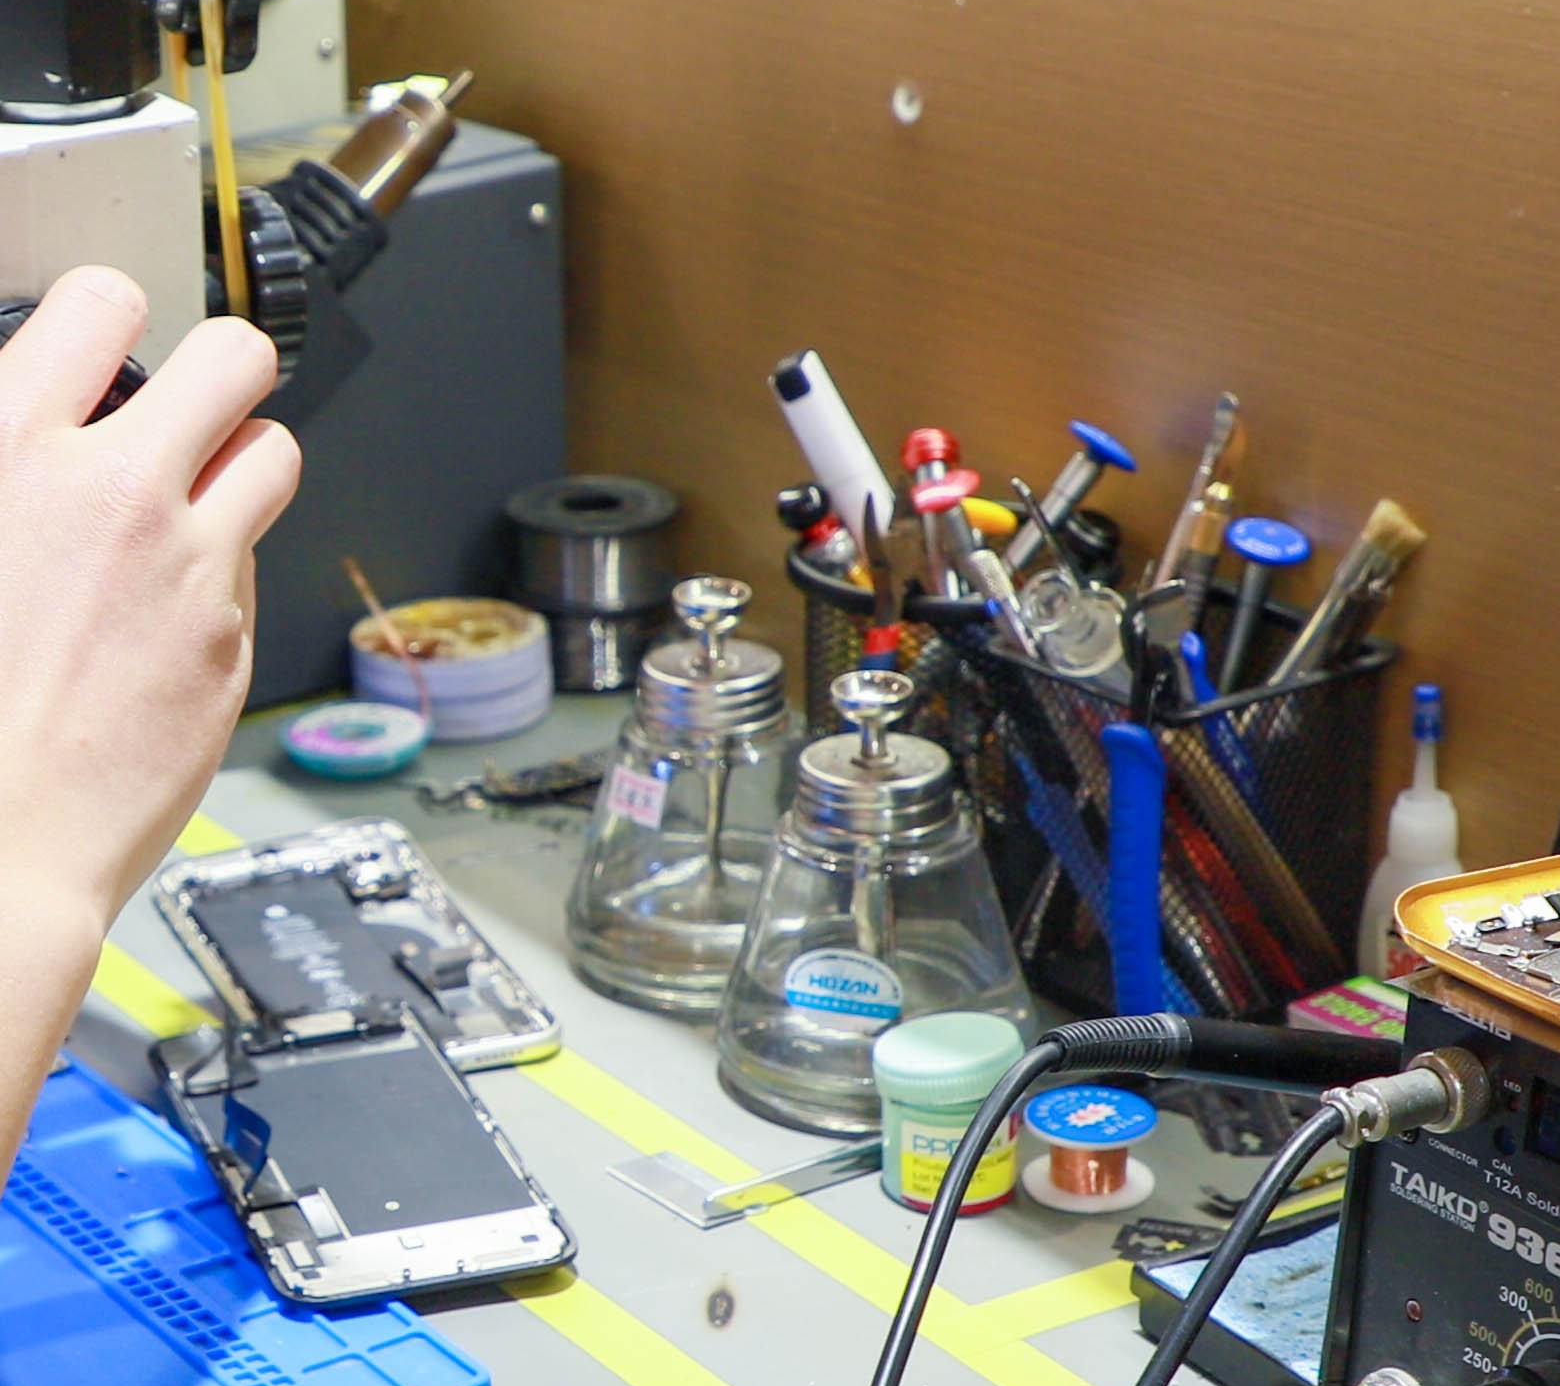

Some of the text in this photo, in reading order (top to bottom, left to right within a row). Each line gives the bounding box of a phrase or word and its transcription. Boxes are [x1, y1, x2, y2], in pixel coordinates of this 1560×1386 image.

[1503, 1079, 1522, 1093] LED
[1428, 1137, 1479, 1167] CONNECTOR
[1492, 1158, 1514, 1176] CAL
[1483, 1170, 1522, 1199] T12A
[1390, 1182, 1476, 1233] SOLDERING STATION
[1498, 1286, 1528, 1312] 300
[1524, 1278, 1554, 1304] 600
[1468, 1321, 1497, 1347] 500
[1462, 1348, 1491, 1374] 250
